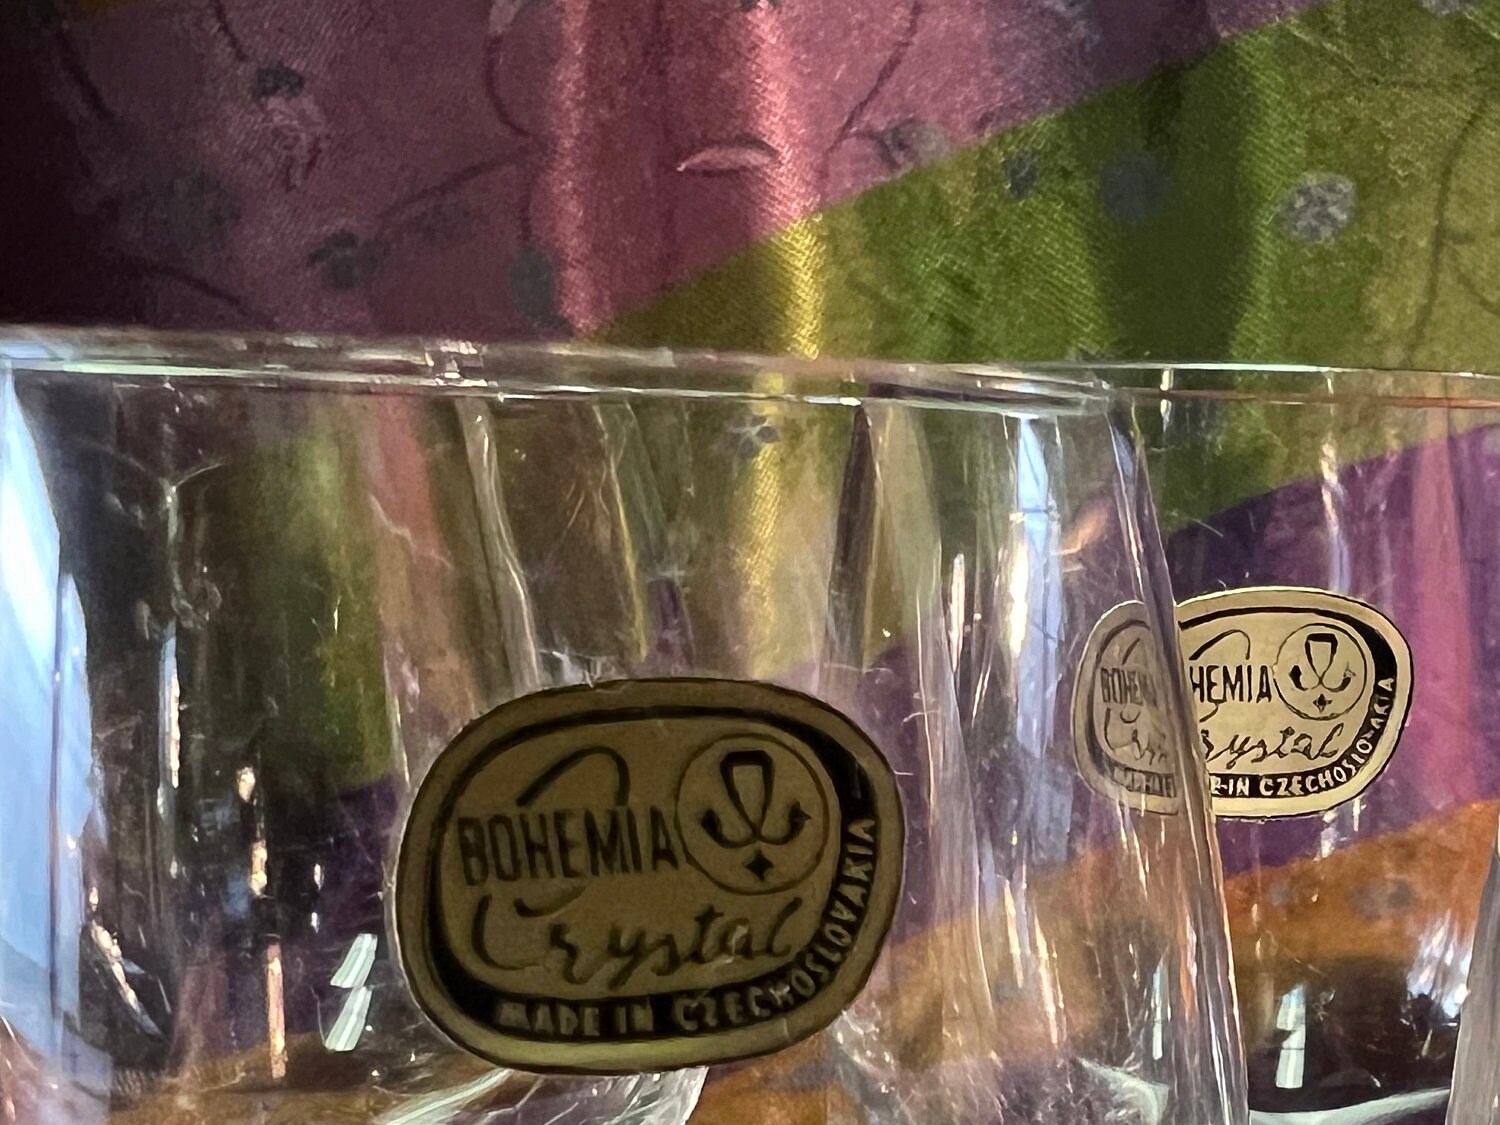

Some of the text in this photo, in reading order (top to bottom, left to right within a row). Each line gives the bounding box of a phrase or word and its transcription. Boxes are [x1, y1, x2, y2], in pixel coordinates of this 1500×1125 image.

[457, 806, 679, 886] BOHEMIA
[471, 888, 803, 990] Crystal
[498, 818, 877, 1037] MADE IN CZECHOSLOVAKIA
